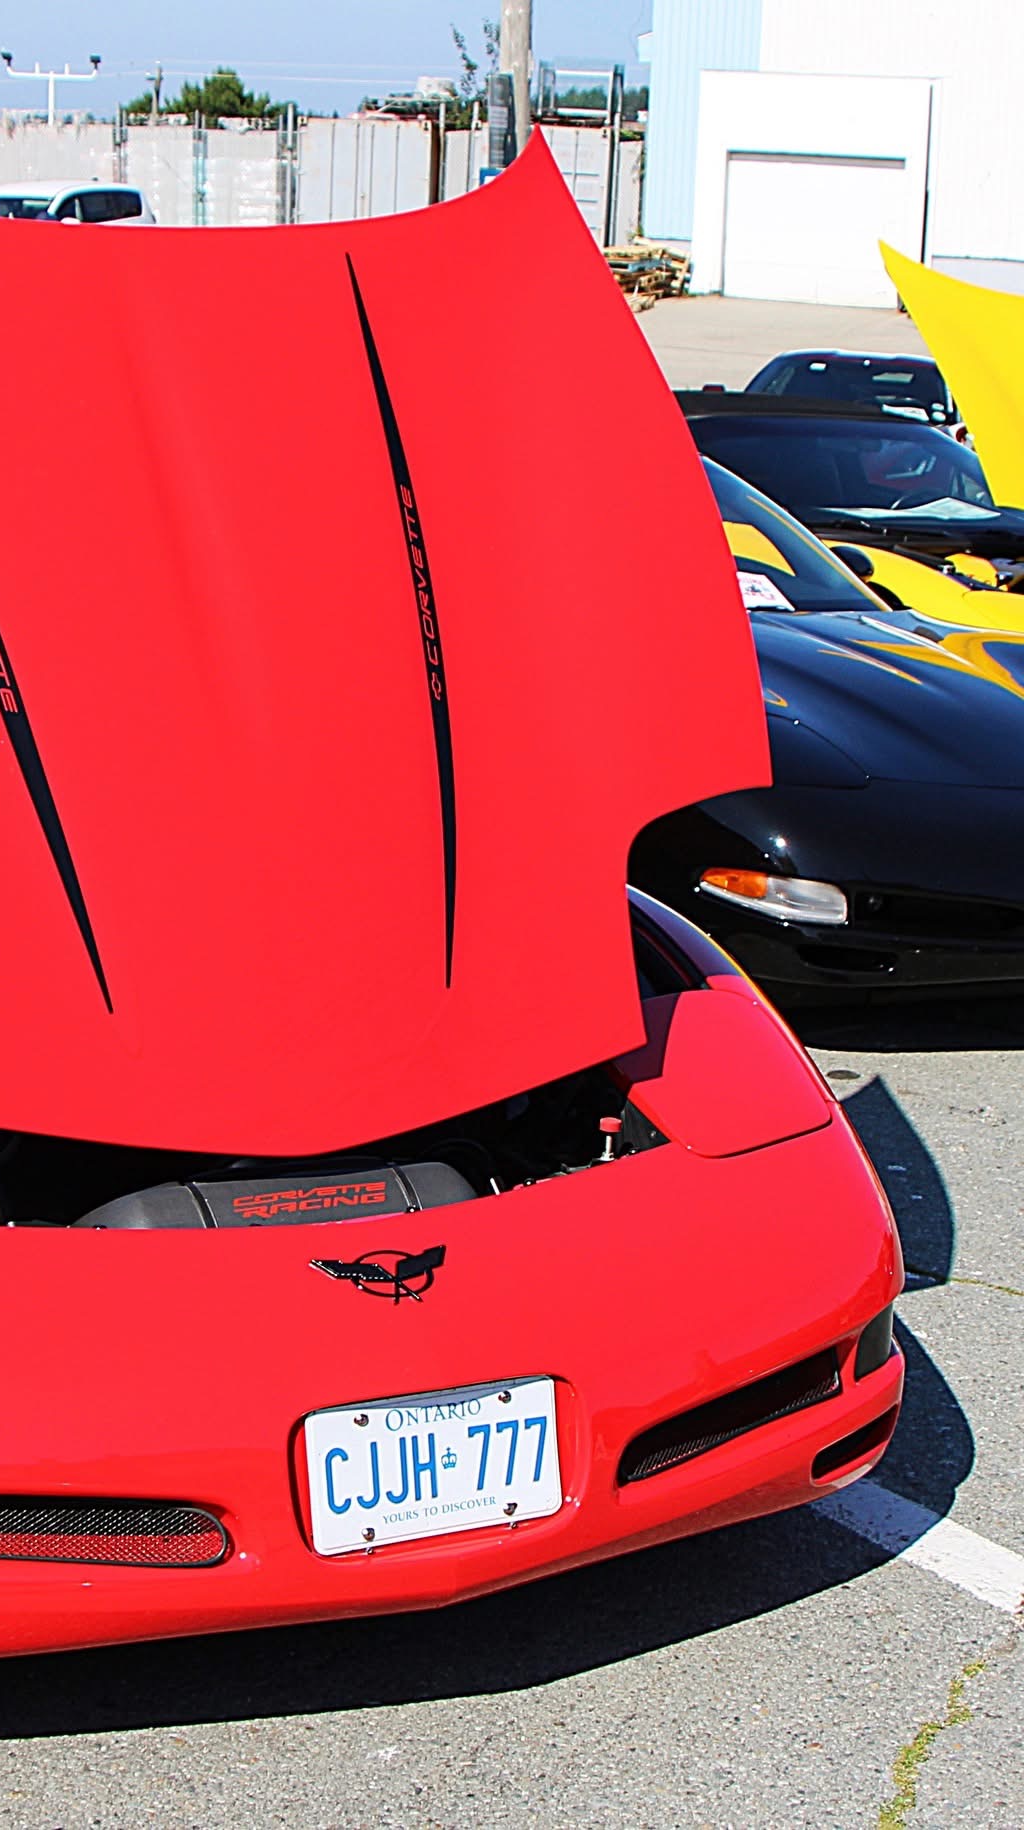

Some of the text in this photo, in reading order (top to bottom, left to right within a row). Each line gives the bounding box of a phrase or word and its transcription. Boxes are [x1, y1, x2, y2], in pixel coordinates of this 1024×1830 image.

[400, 484, 439, 666] CORVETTE
[233, 1182, 386, 1207] CORVETTE
[234, 1193, 386, 1218] RACING
[325, 1416, 547, 1515] CJJH 777
[382, 1496, 496, 1525] YOURS TO DISCOVER
